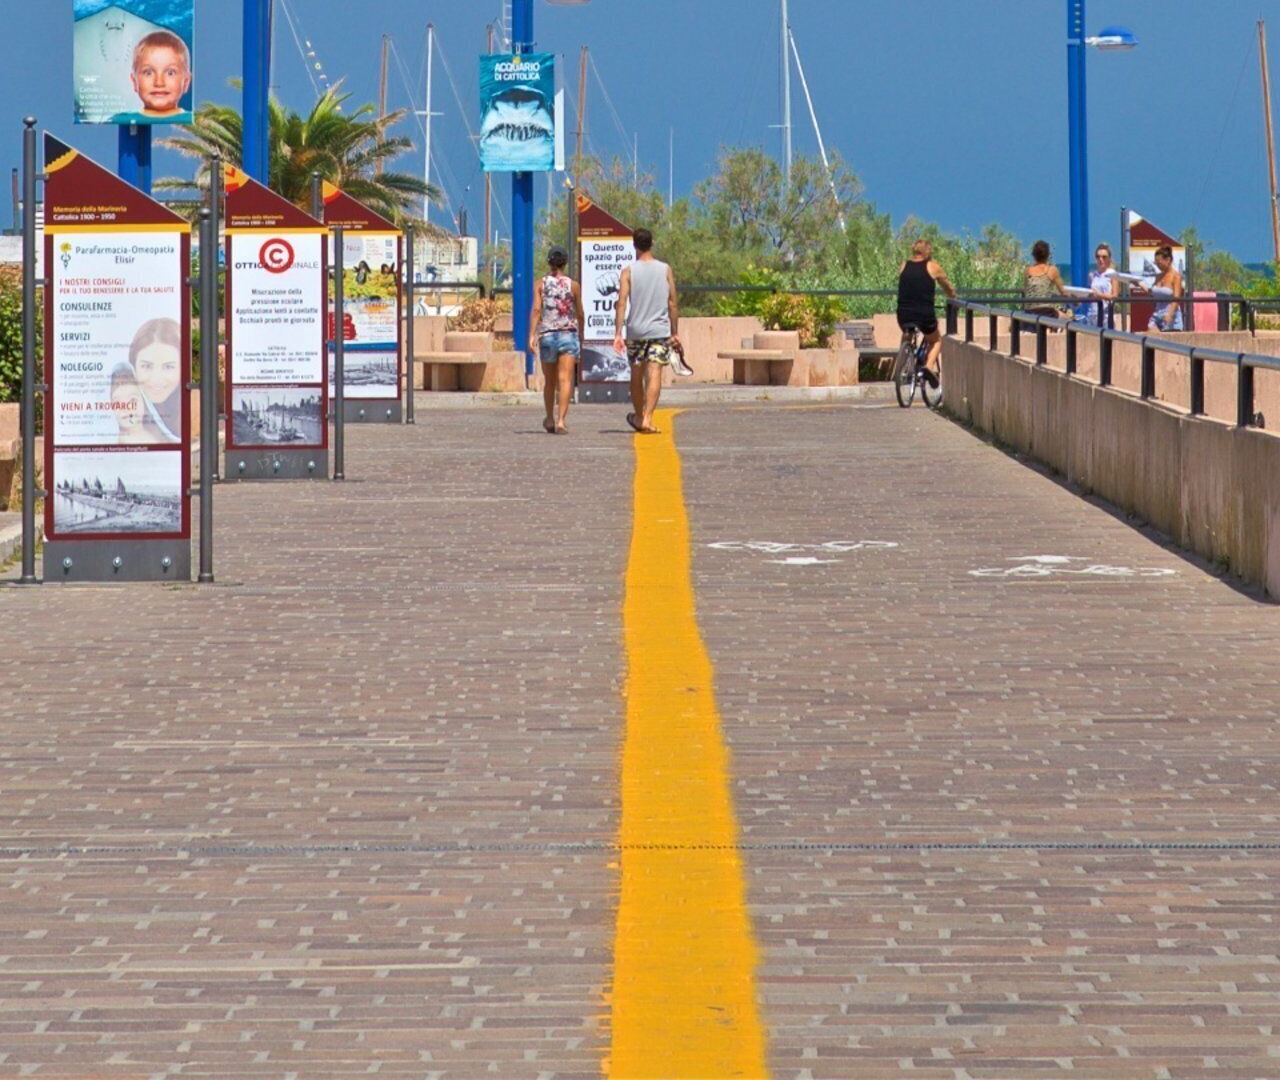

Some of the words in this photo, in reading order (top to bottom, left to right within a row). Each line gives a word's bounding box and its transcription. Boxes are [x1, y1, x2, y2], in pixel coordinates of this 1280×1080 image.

[494, 62, 540, 72] ACQUARIO
[495, 73, 502, 81] DI
[503, 72, 540, 81] CATTOLICA
[592, 243, 625, 252] Questo
[114, 256, 136, 264] Elisir
[585, 254, 612, 263] spazio
[615, 252, 633, 262] può
[65, 278, 90, 286] NOSTRI
[92, 278, 126, 286] CONSIGLI
[60, 302, 112, 311] CONSULENZE
[60, 332, 91, 341] SERVIZI
[60, 363, 104, 371] NOLEGGIO
[61, 402, 84, 411] VIENI
[86, 402, 93, 410] A
[95, 401, 138, 410] TROVARCI!
